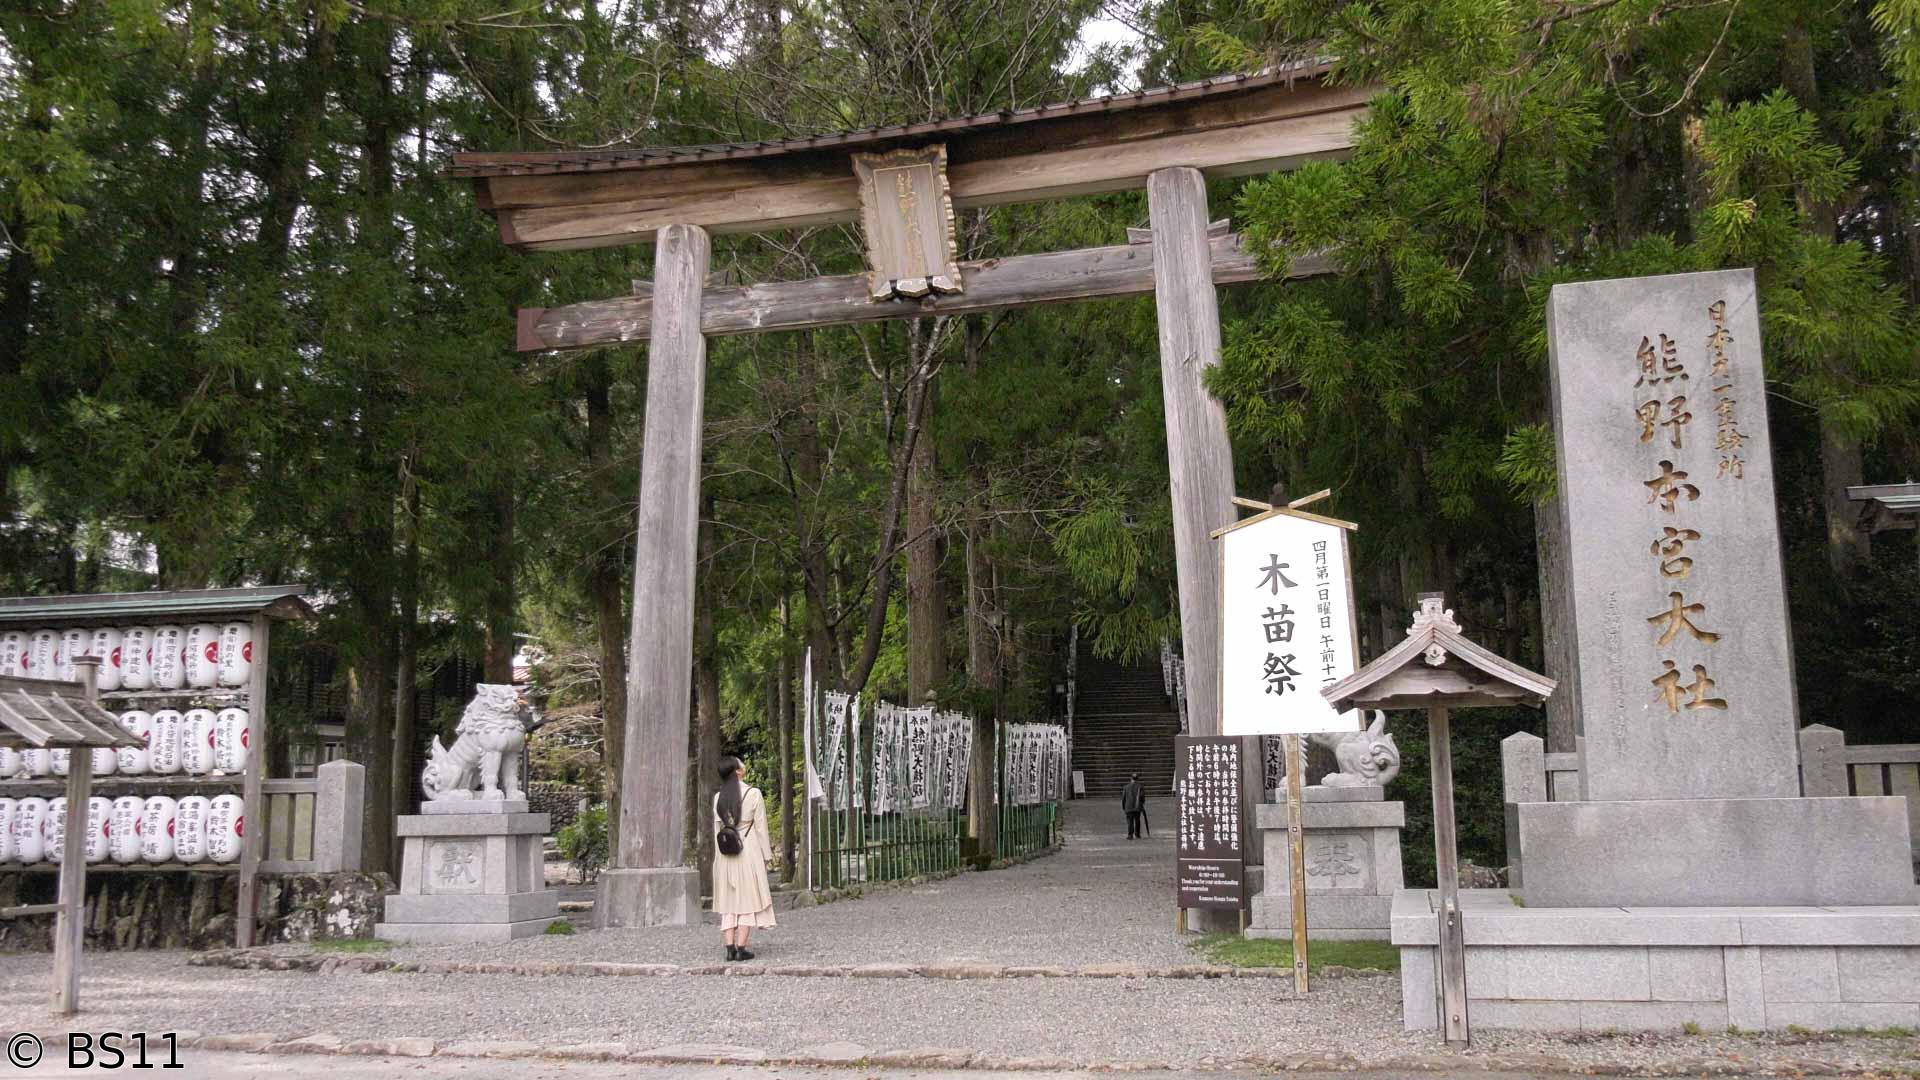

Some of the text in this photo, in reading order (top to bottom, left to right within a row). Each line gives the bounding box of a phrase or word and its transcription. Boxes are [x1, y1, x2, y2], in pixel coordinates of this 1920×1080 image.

[1633, 332, 1729, 712] 熊野本宮大社
[1256, 553, 1303, 697] 木苗祭
[1312, 540, 1337, 689] 四月第一日曜日 午前十一
